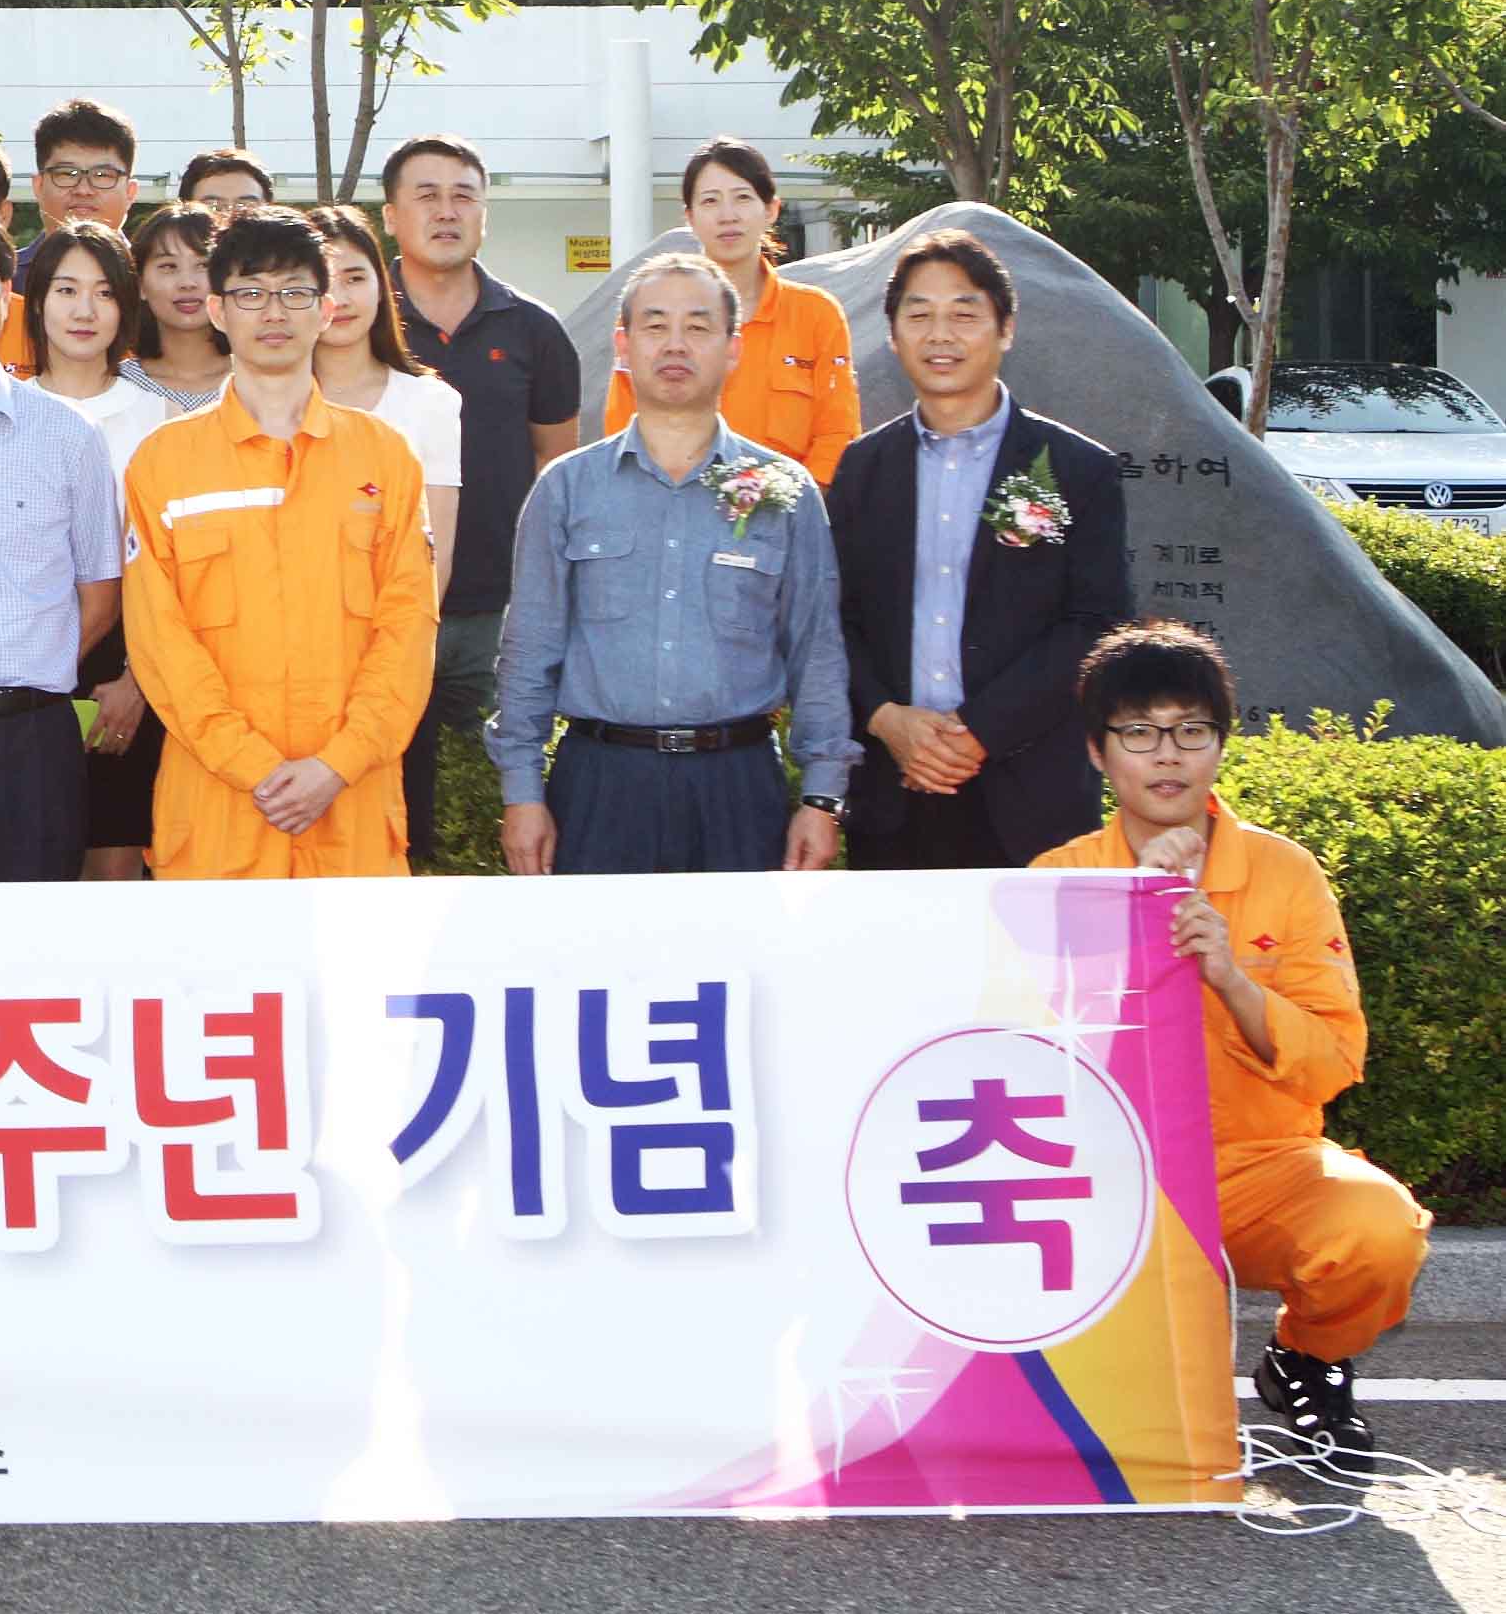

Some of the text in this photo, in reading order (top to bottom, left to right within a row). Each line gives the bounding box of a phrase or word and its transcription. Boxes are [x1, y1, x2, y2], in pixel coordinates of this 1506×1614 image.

[1152, 543, 1223, 564] 계기로
[385, 981, 739, 1217] 기념
[897, 1078, 1093, 1292] 축
